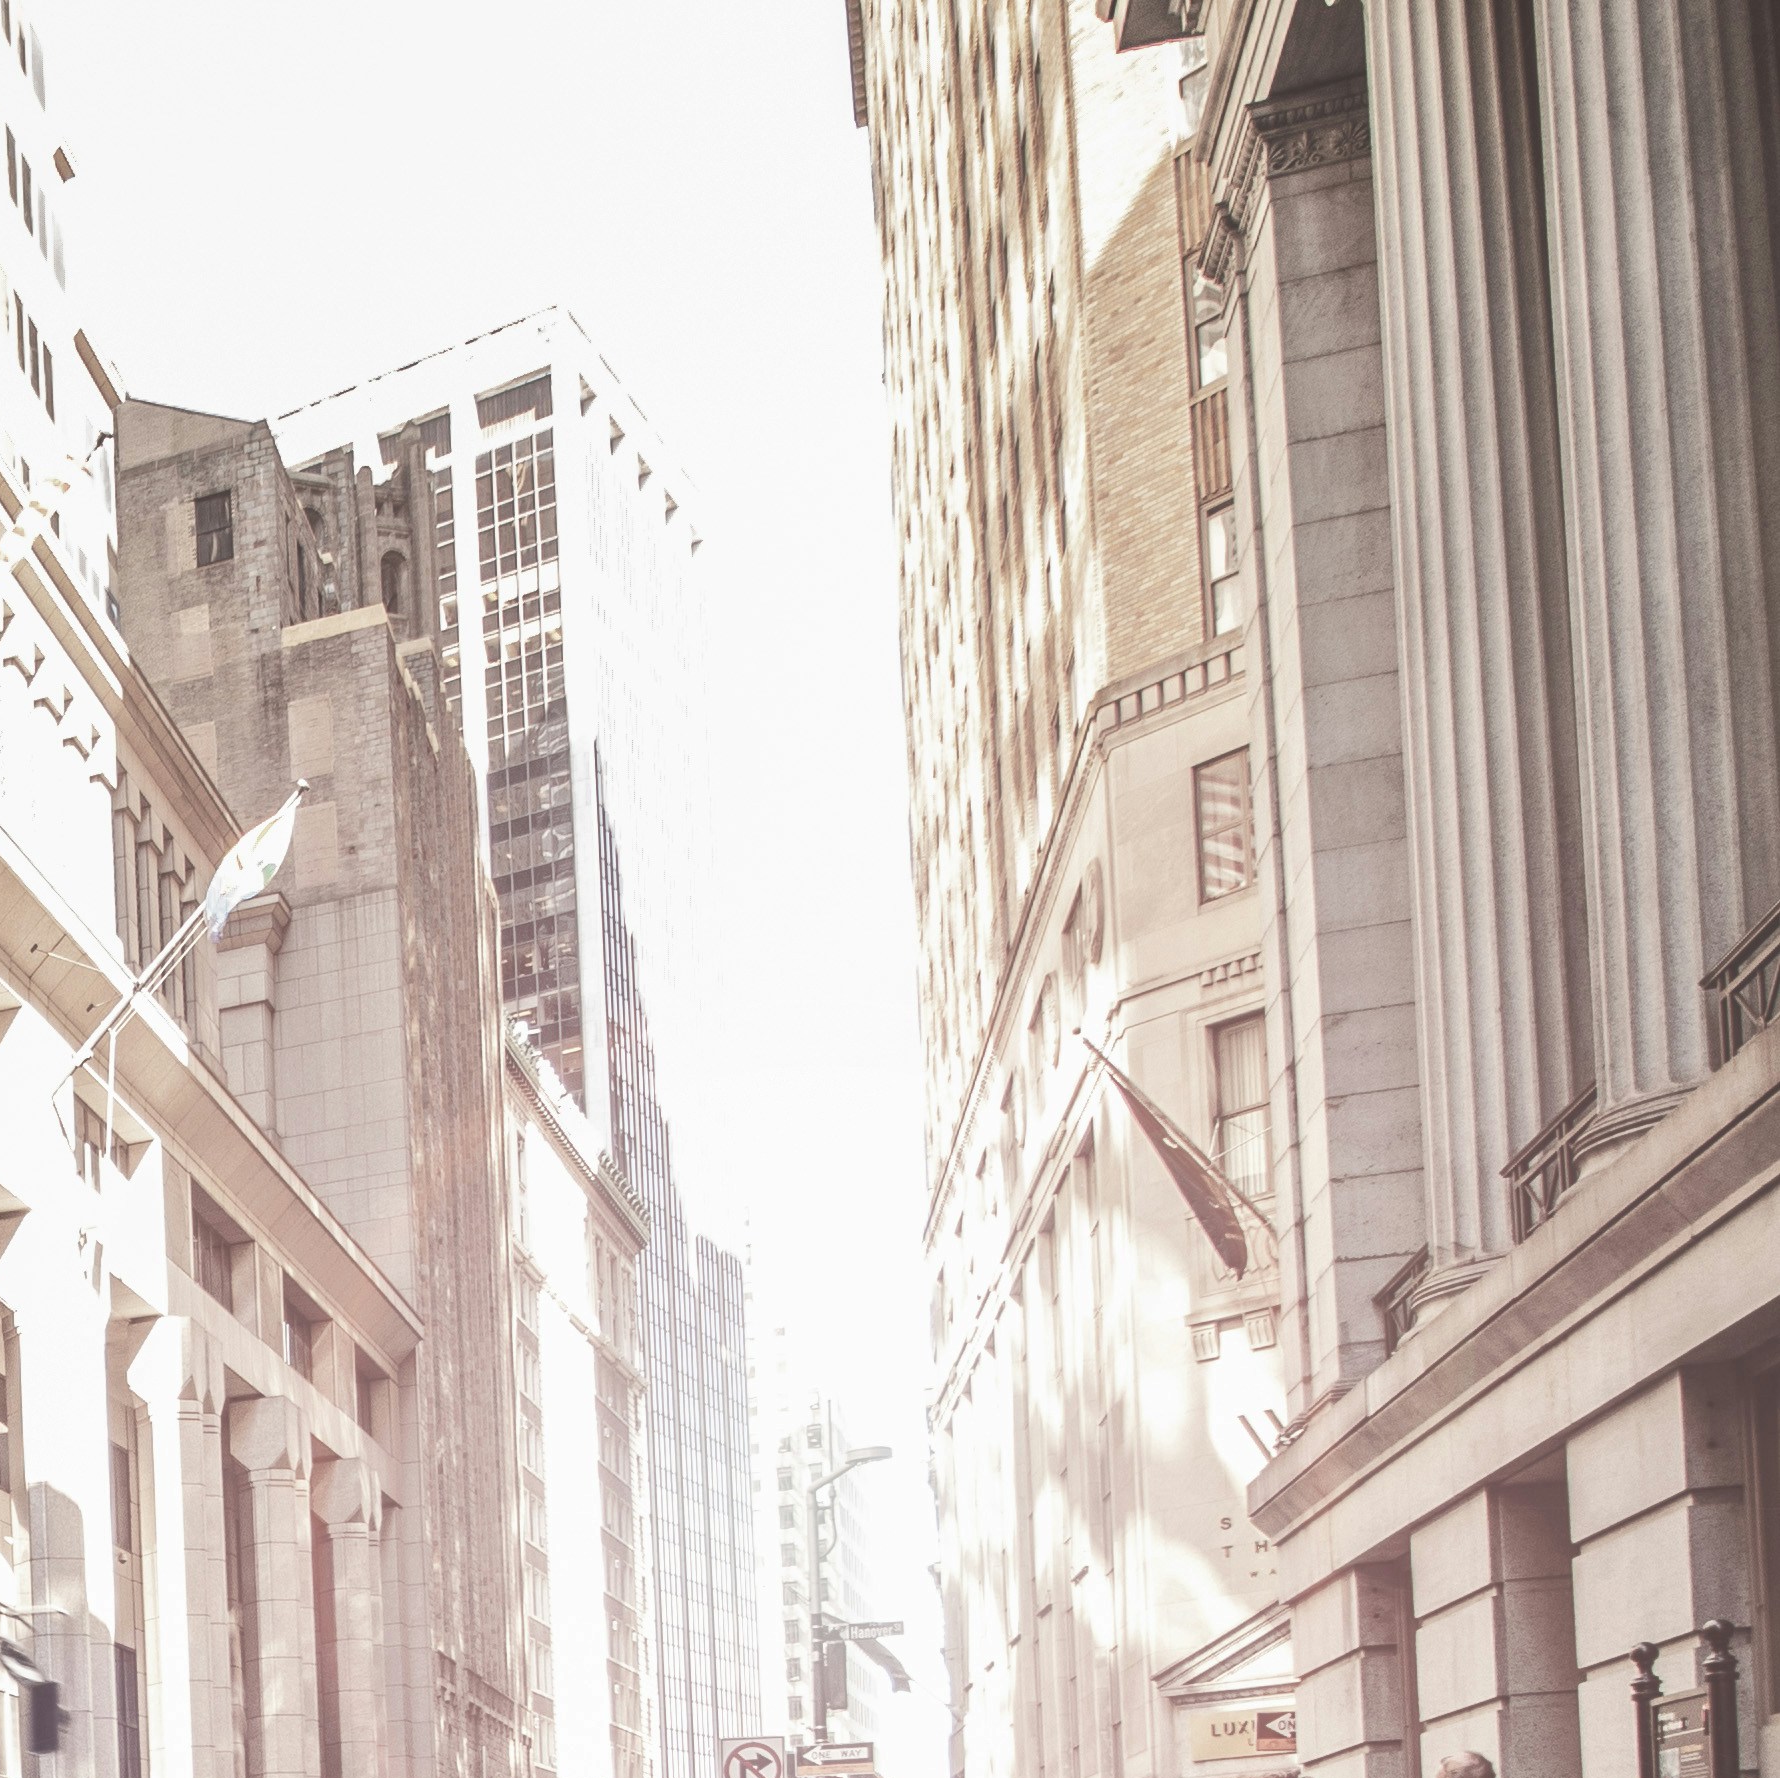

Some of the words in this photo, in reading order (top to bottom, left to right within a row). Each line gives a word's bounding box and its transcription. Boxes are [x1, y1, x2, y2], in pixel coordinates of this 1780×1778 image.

[850, 1625, 893, 1640] Hanover
[811, 1750, 832, 1760] ONE
[840, 1749, 861, 1758] WAY
